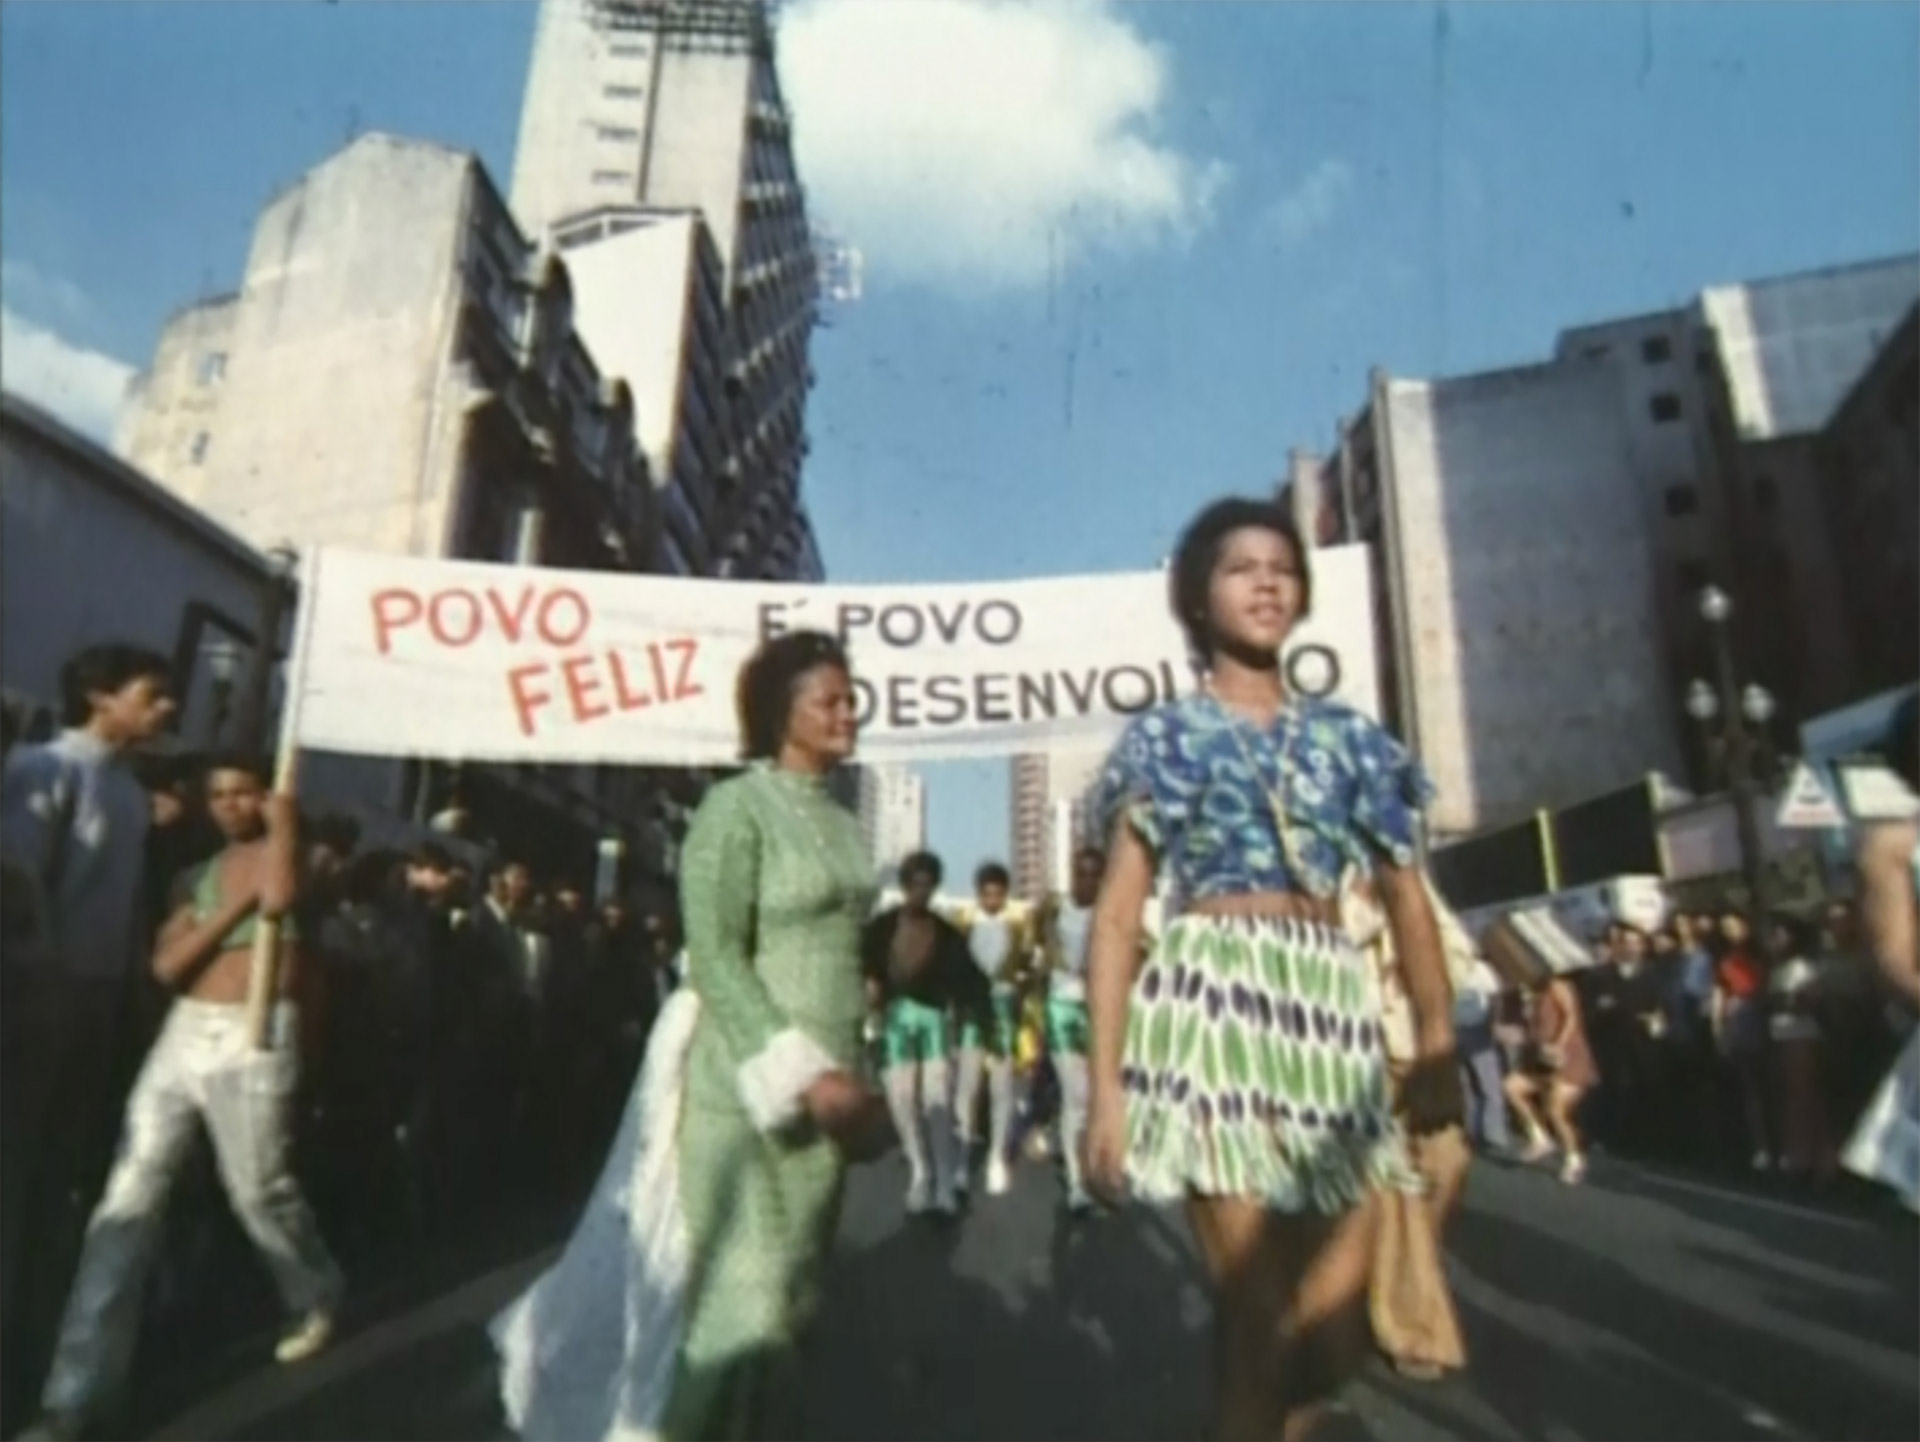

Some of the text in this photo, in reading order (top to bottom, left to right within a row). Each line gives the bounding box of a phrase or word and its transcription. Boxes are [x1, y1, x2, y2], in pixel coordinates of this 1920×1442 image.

[370, 585, 591, 655] POVO
[837, 599, 1023, 648] POVO
[507, 639, 705, 737] FELIZ
